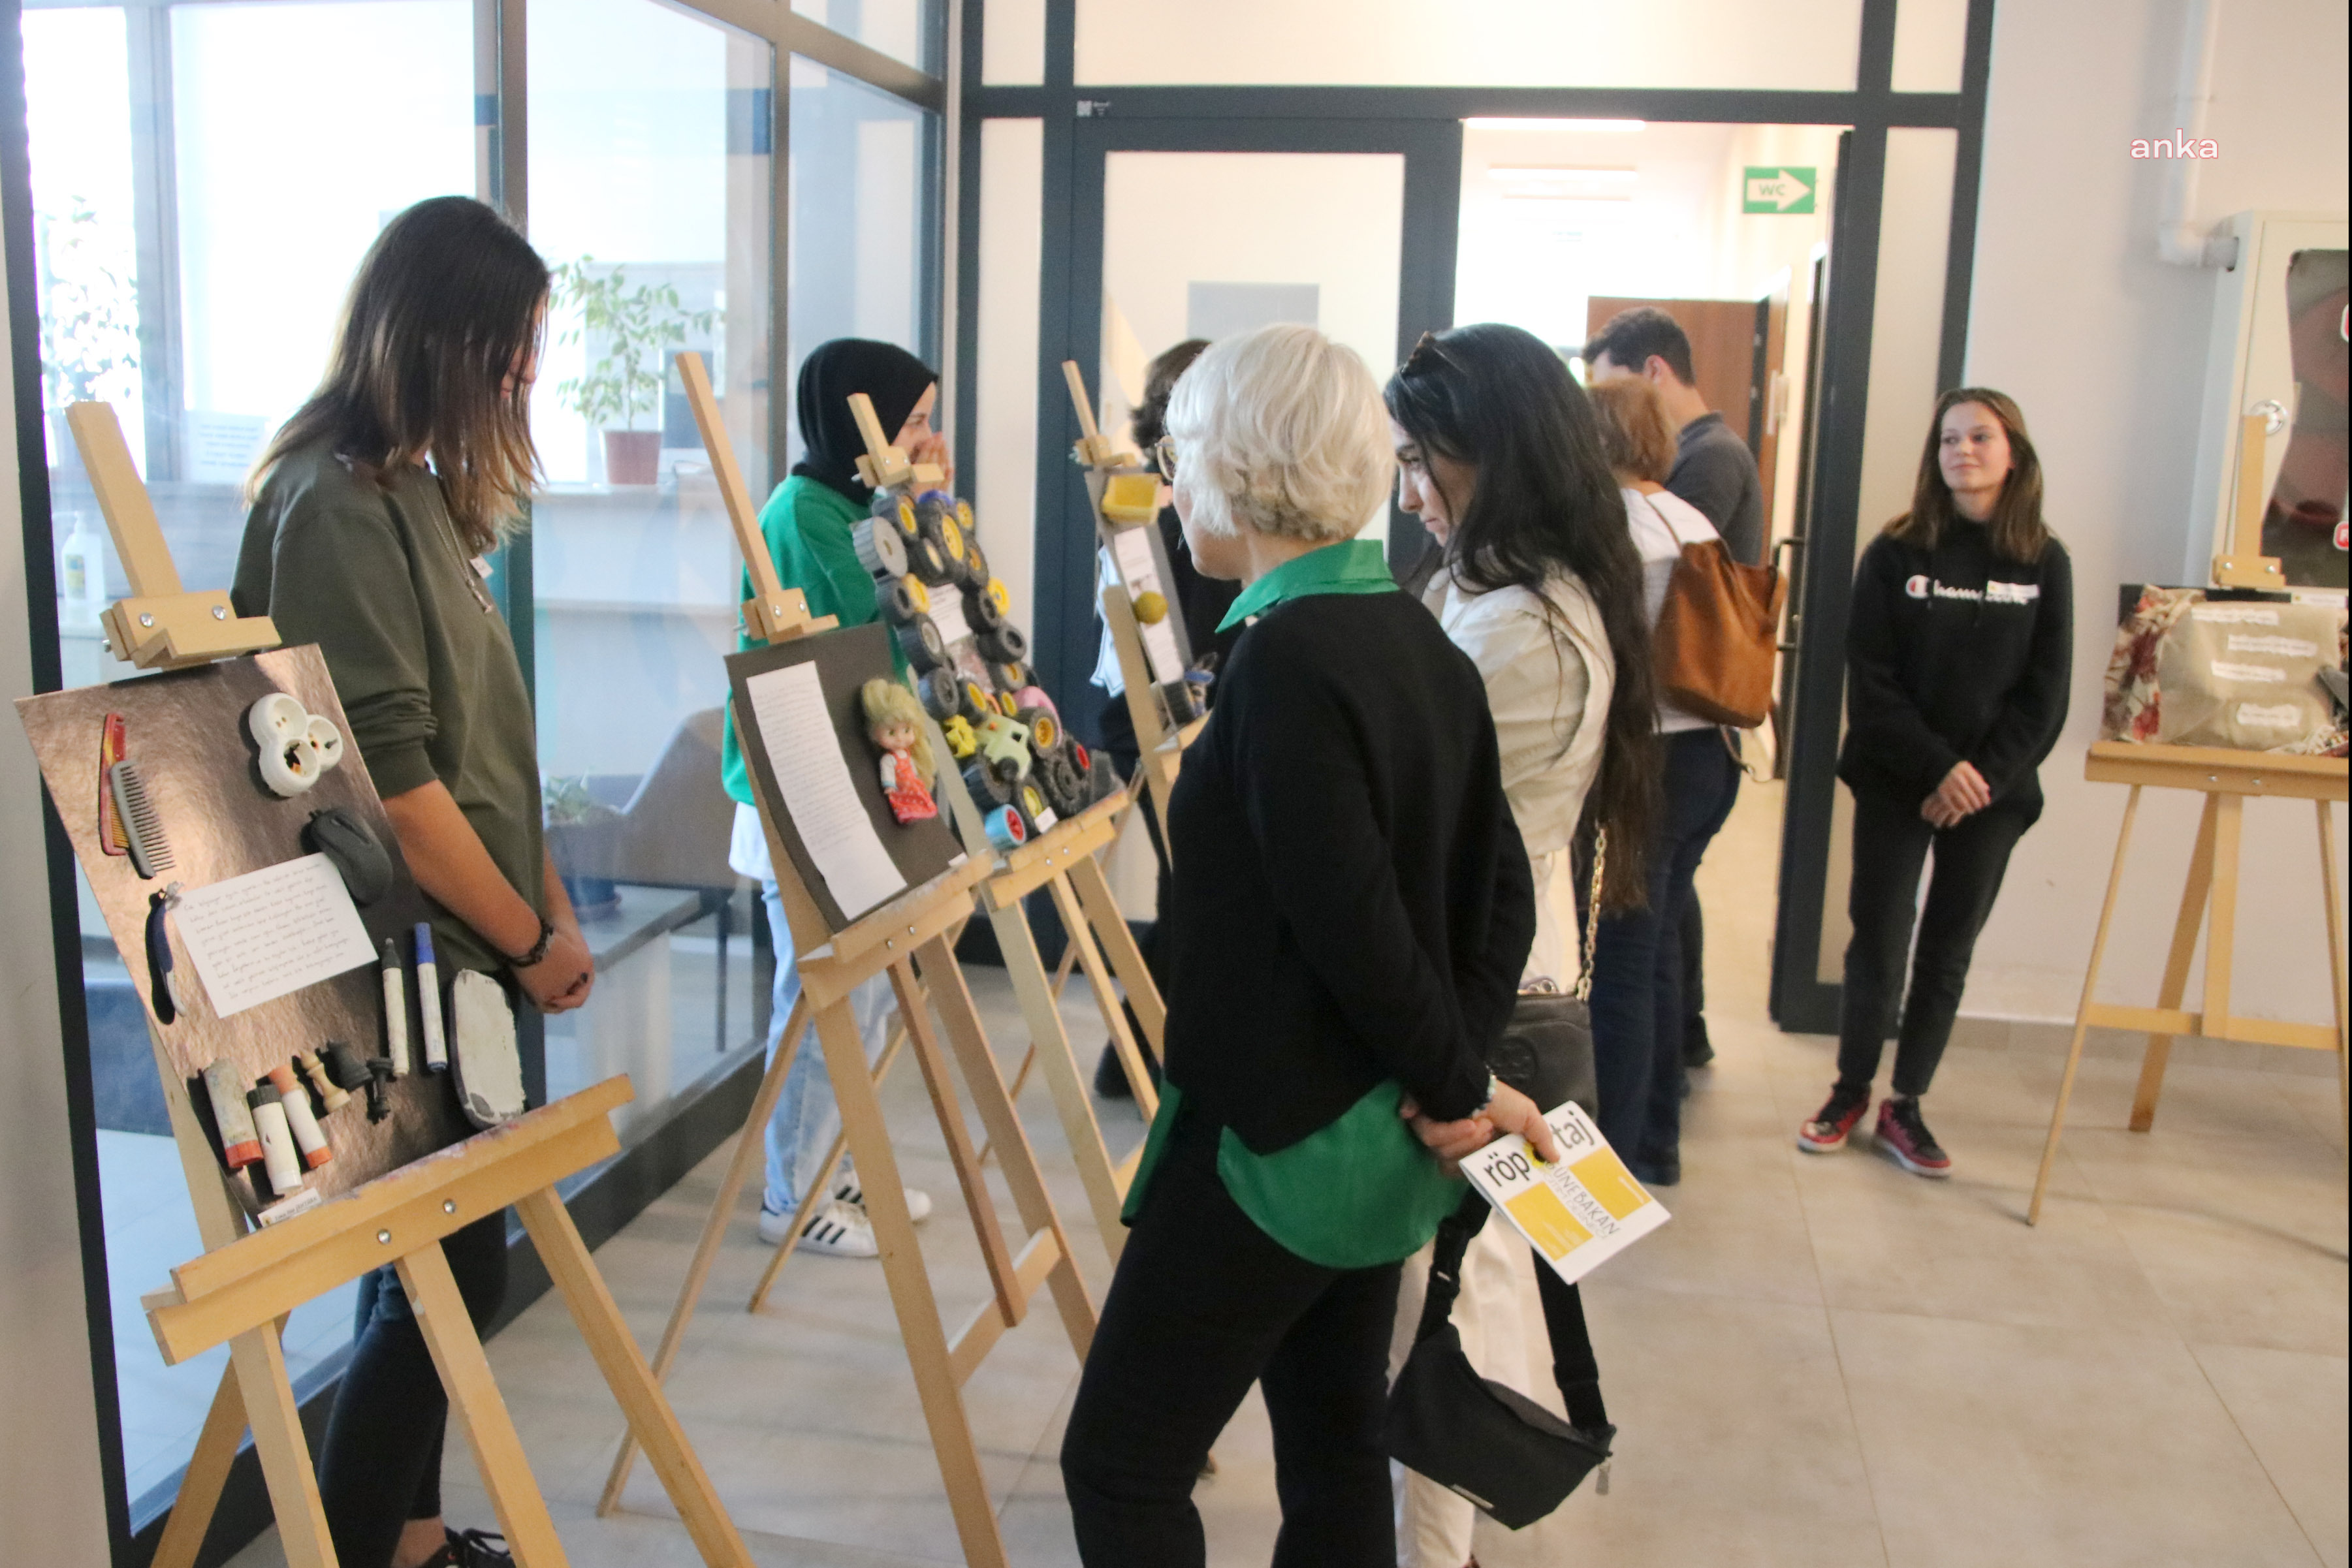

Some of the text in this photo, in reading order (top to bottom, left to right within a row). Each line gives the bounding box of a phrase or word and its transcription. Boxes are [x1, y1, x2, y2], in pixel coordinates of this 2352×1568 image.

[1759, 183, 1787, 196] WC
[1484, 1110, 1595, 1187] röp taj
